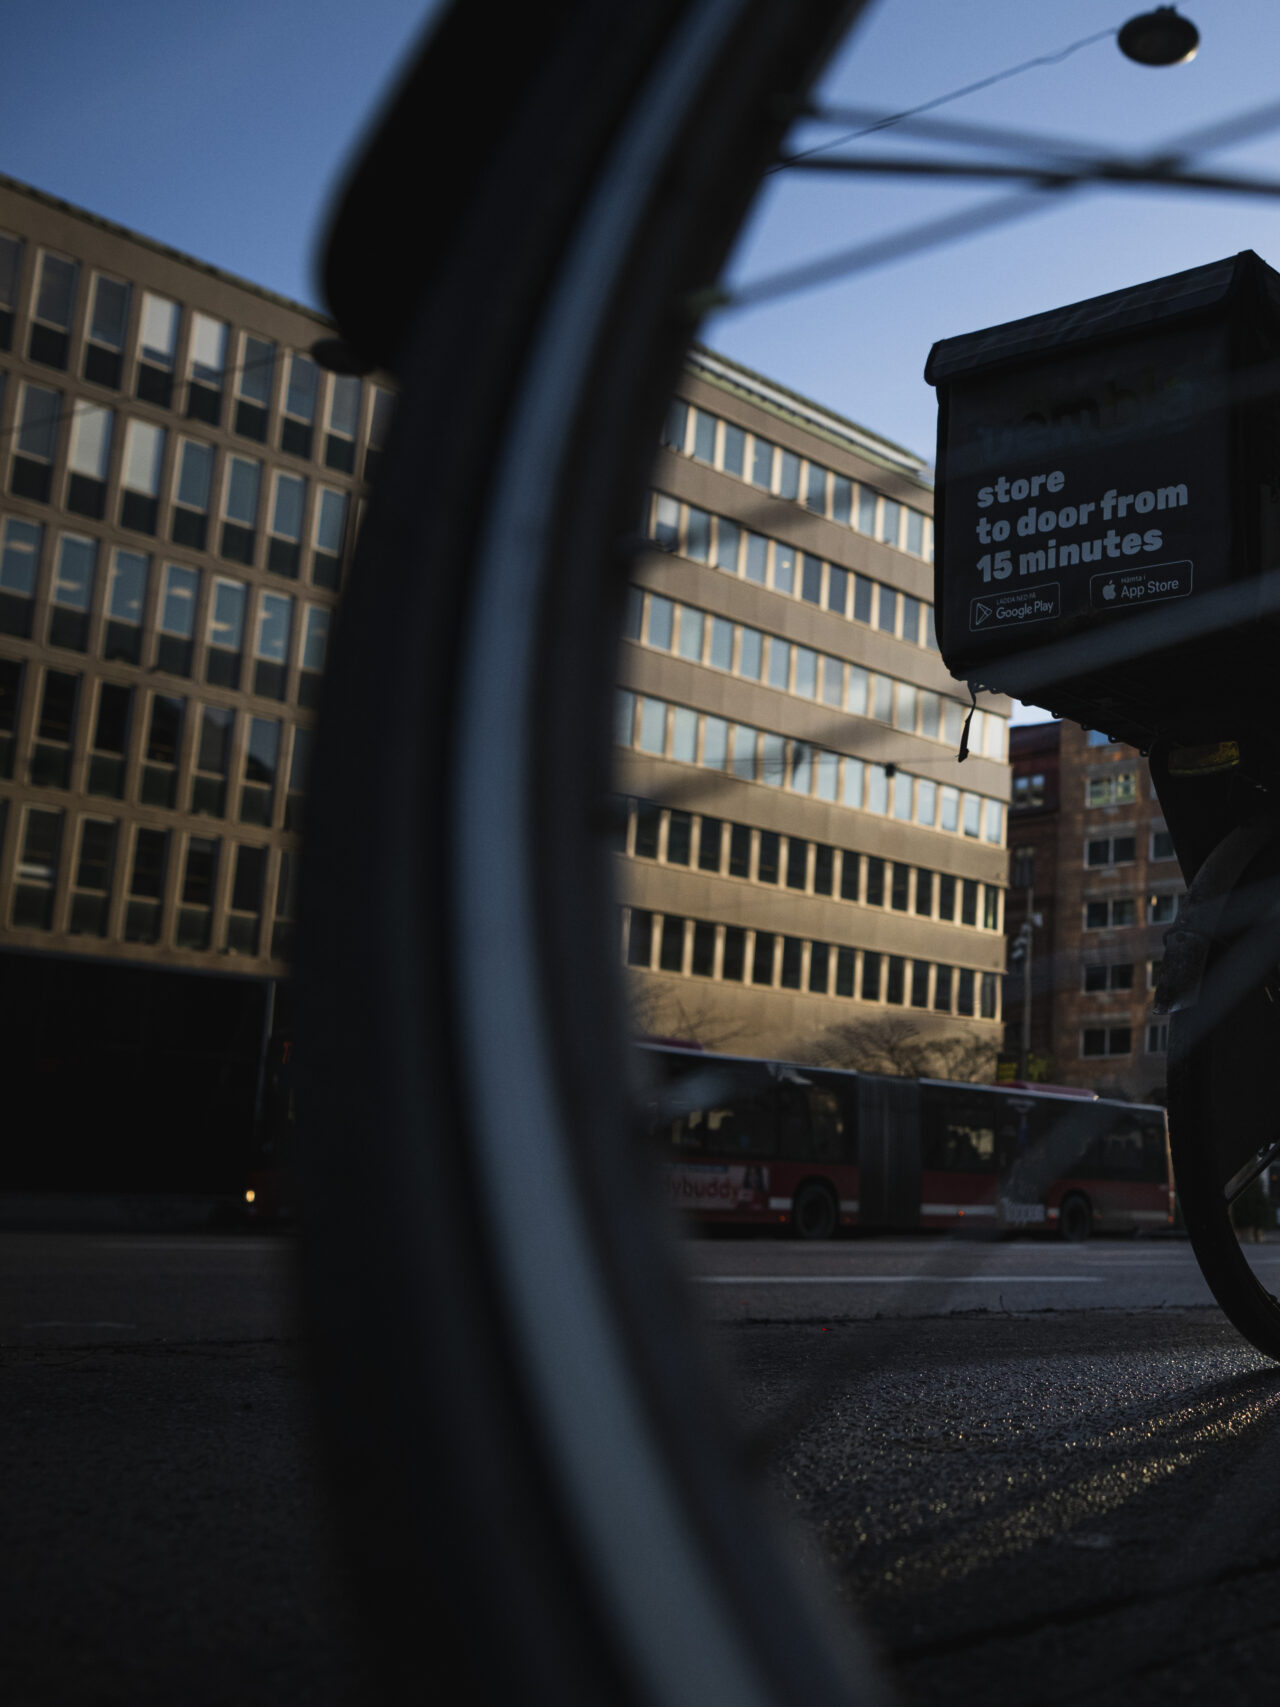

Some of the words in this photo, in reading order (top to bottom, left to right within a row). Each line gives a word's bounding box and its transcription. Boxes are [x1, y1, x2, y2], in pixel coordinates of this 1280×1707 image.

[977, 470, 1066, 508] store
[975, 517, 1011, 544] to
[1016, 501, 1095, 537] door
[1100, 483, 1188, 520] from
[976, 550, 1013, 583] 15
[1019, 529, 1163, 576] minutes
[1120, 584, 1145, 599] App
[1147, 579, 1179, 594] Store
[996, 602, 1032, 619] Google
[1034, 600, 1054, 614] Play
